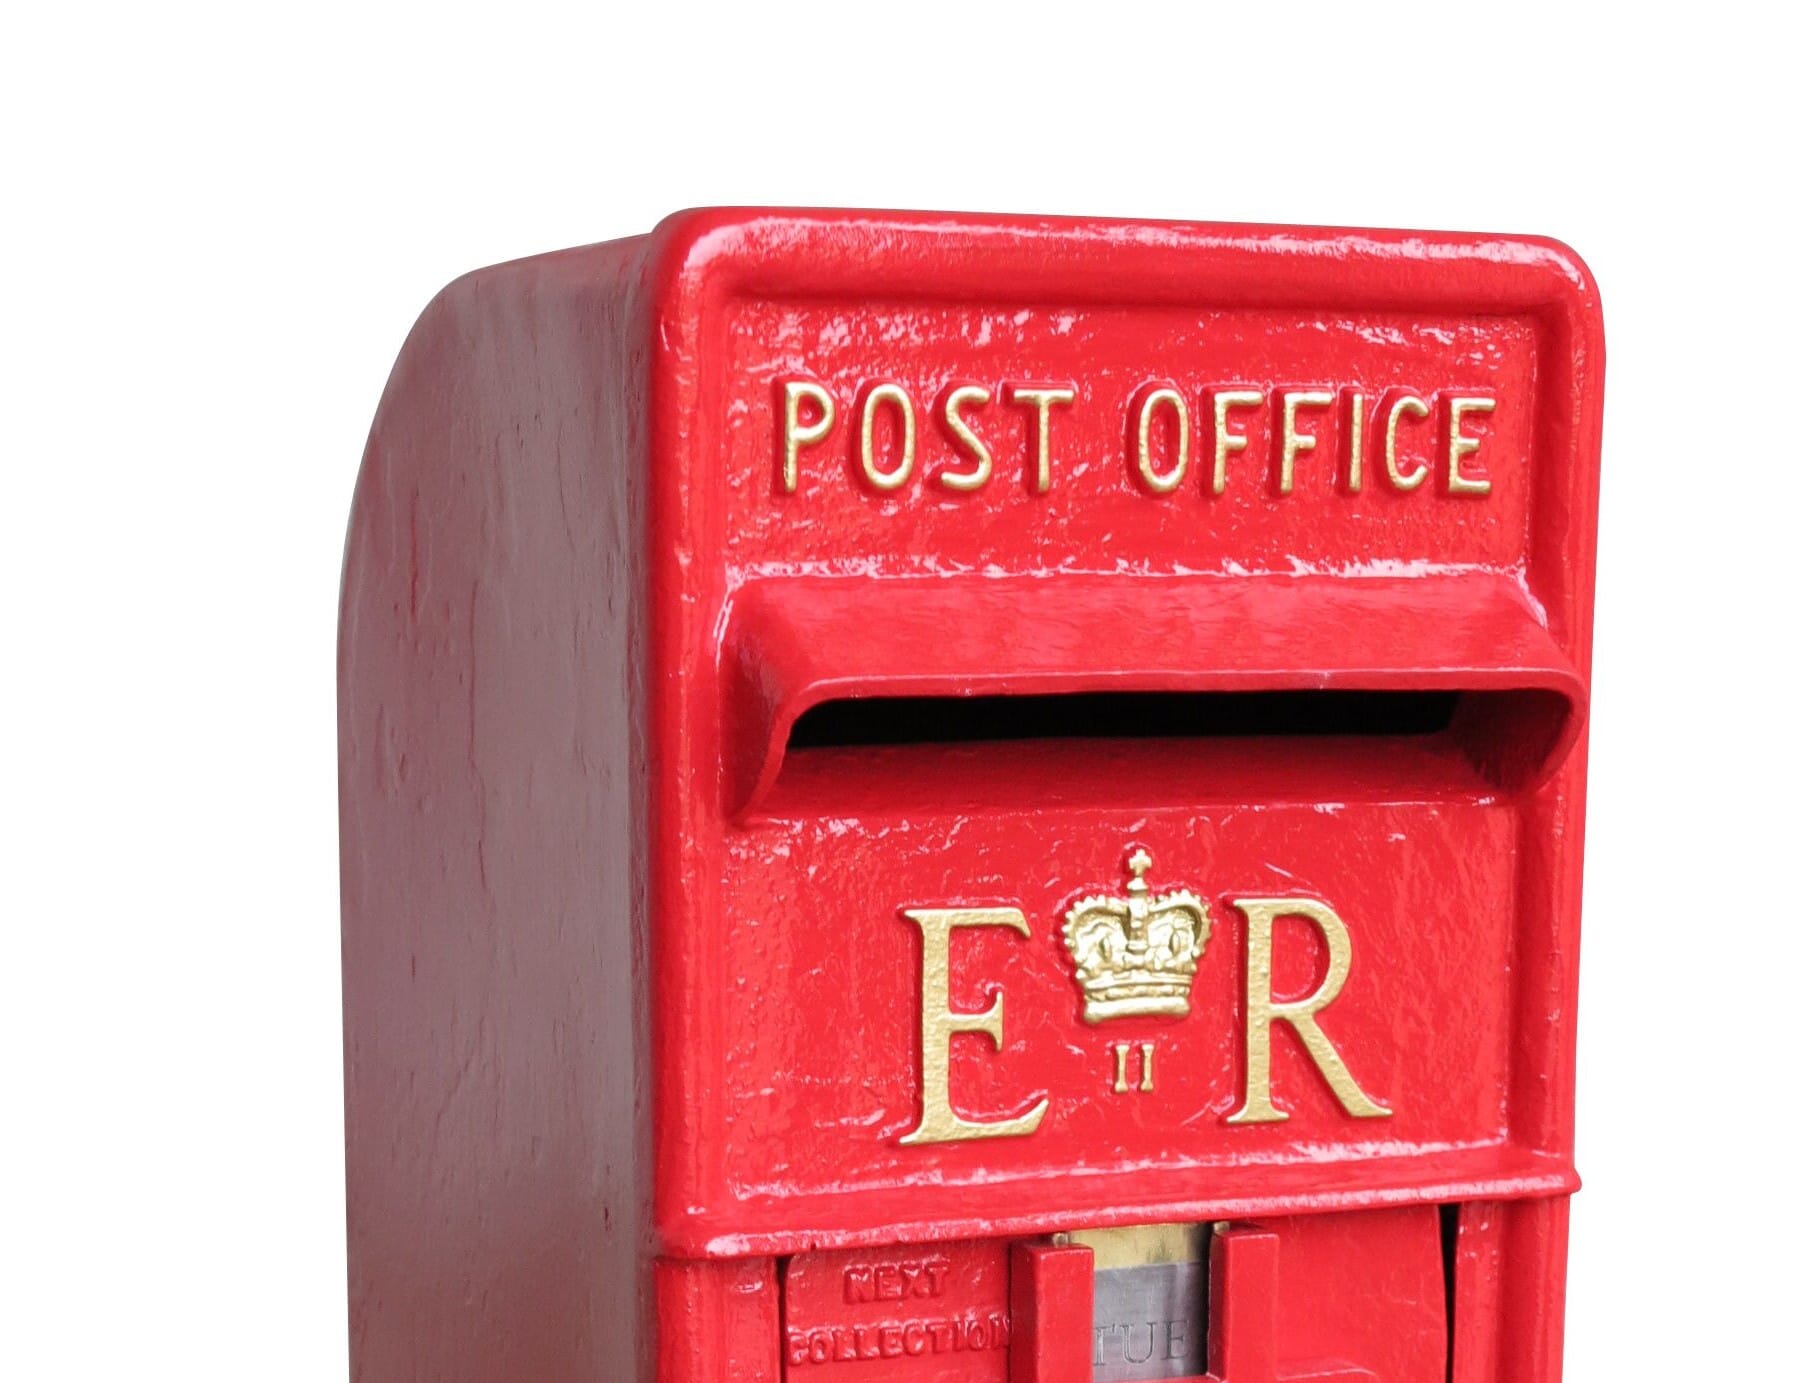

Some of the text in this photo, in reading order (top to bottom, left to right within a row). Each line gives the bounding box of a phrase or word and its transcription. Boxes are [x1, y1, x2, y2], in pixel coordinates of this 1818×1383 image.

[779, 380, 1498, 495] POST OFFICE
[899, 896, 1393, 1145] E R
[1110, 1043, 1155, 1094] II
[843, 1256, 951, 1303] NEXT
[786, 1310, 1012, 1366] COLLECTION
[1093, 1319, 1190, 1367] TUE
